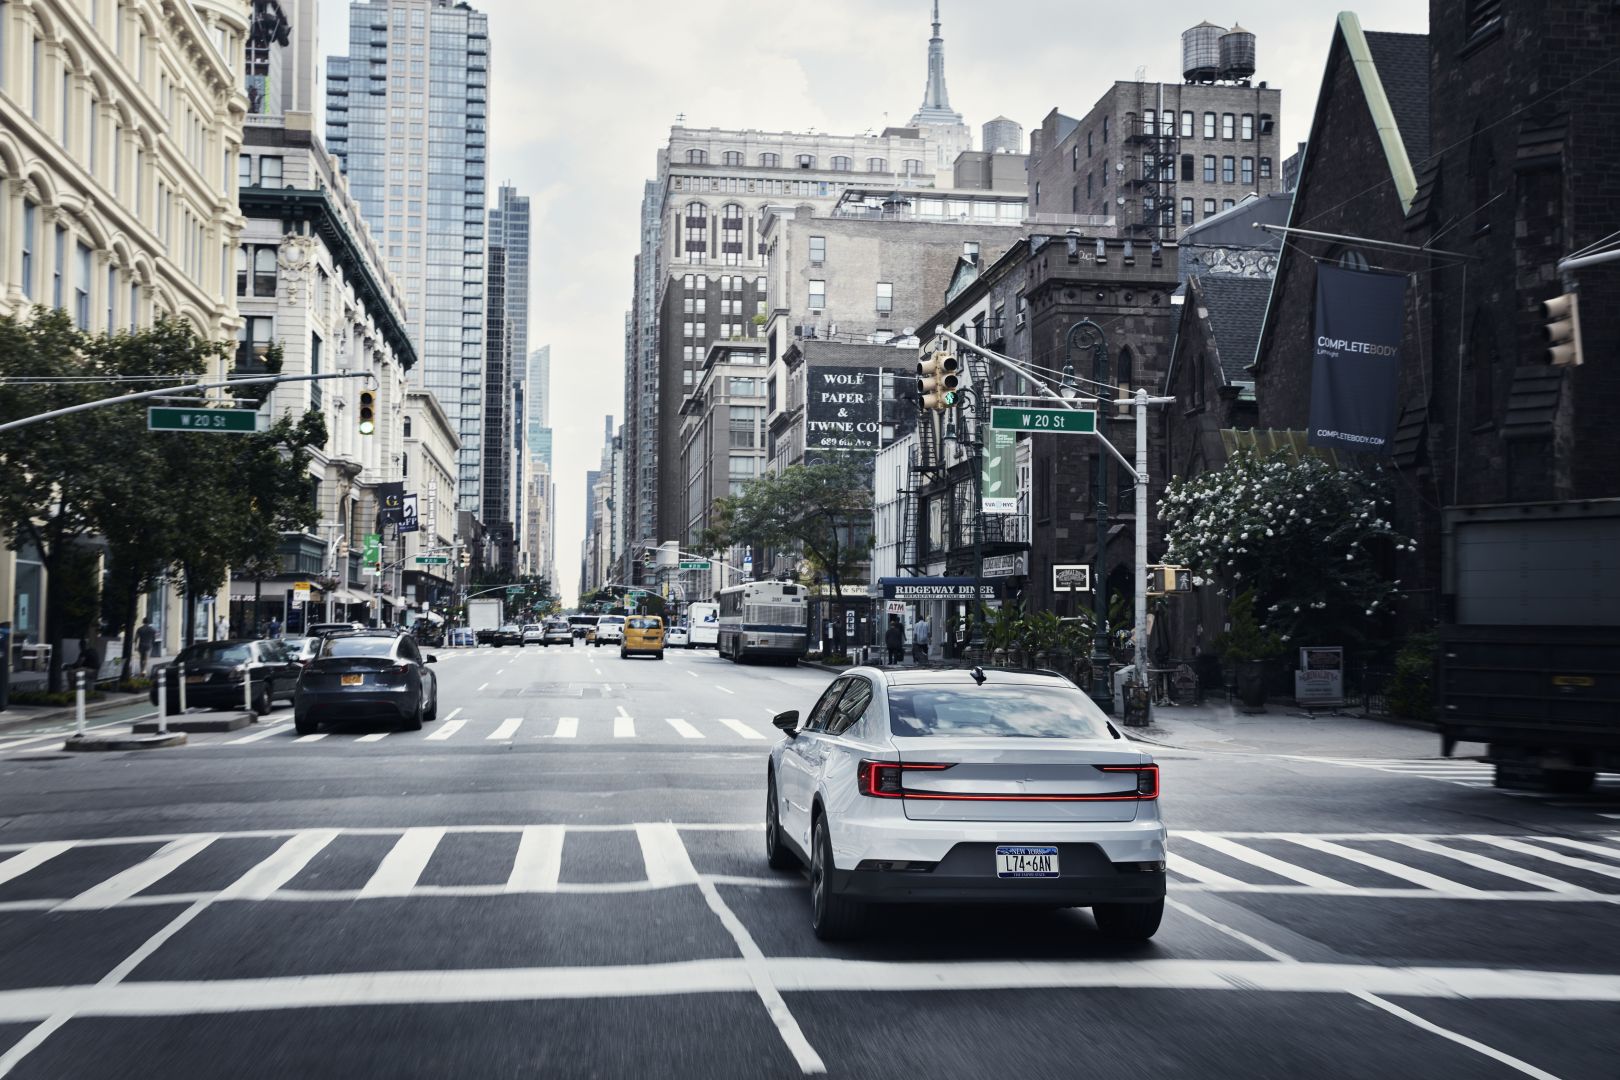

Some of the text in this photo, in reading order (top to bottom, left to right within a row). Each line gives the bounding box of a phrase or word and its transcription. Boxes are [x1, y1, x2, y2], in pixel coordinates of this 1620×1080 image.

[1317, 336, 1398, 356] COMPLETEBODY
[821, 392, 865, 404] PAPER
[837, 407, 849, 418] &
[181, 414, 227, 427] W 20 St
[1022, 414, 1065, 428] W 20 St
[808, 421, 854, 432] TWINE
[855, 438, 872, 447] Ave
[1317, 429, 1385, 445] COMPLETEBODY.COM
[895, 585, 955, 594] RIDGEWAY
[888, 602, 905, 612] ATM
